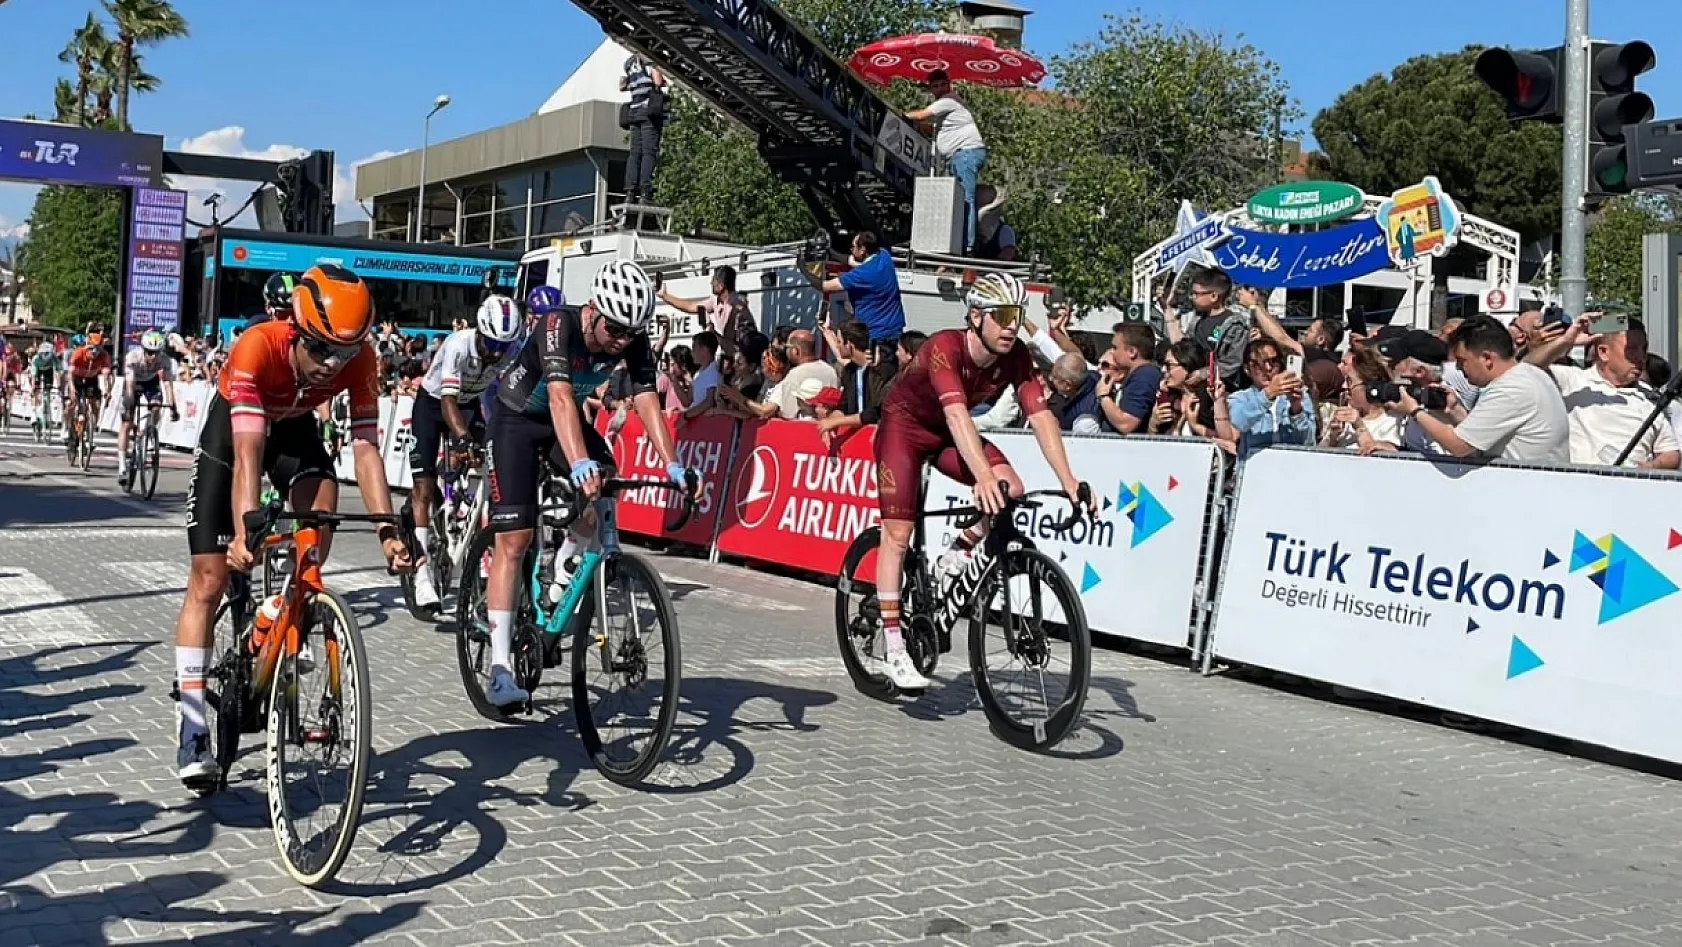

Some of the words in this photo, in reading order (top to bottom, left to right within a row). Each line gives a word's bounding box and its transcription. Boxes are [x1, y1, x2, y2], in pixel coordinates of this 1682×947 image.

[635, 436, 722, 475] TUKISH
[792, 453, 879, 499] TURKIS
[1265, 531, 1352, 584] Türk
[1366, 545, 1566, 620] Telekom
[1261, 578, 1328, 610] Değerli
[1333, 591, 1432, 628] Hissettirir
